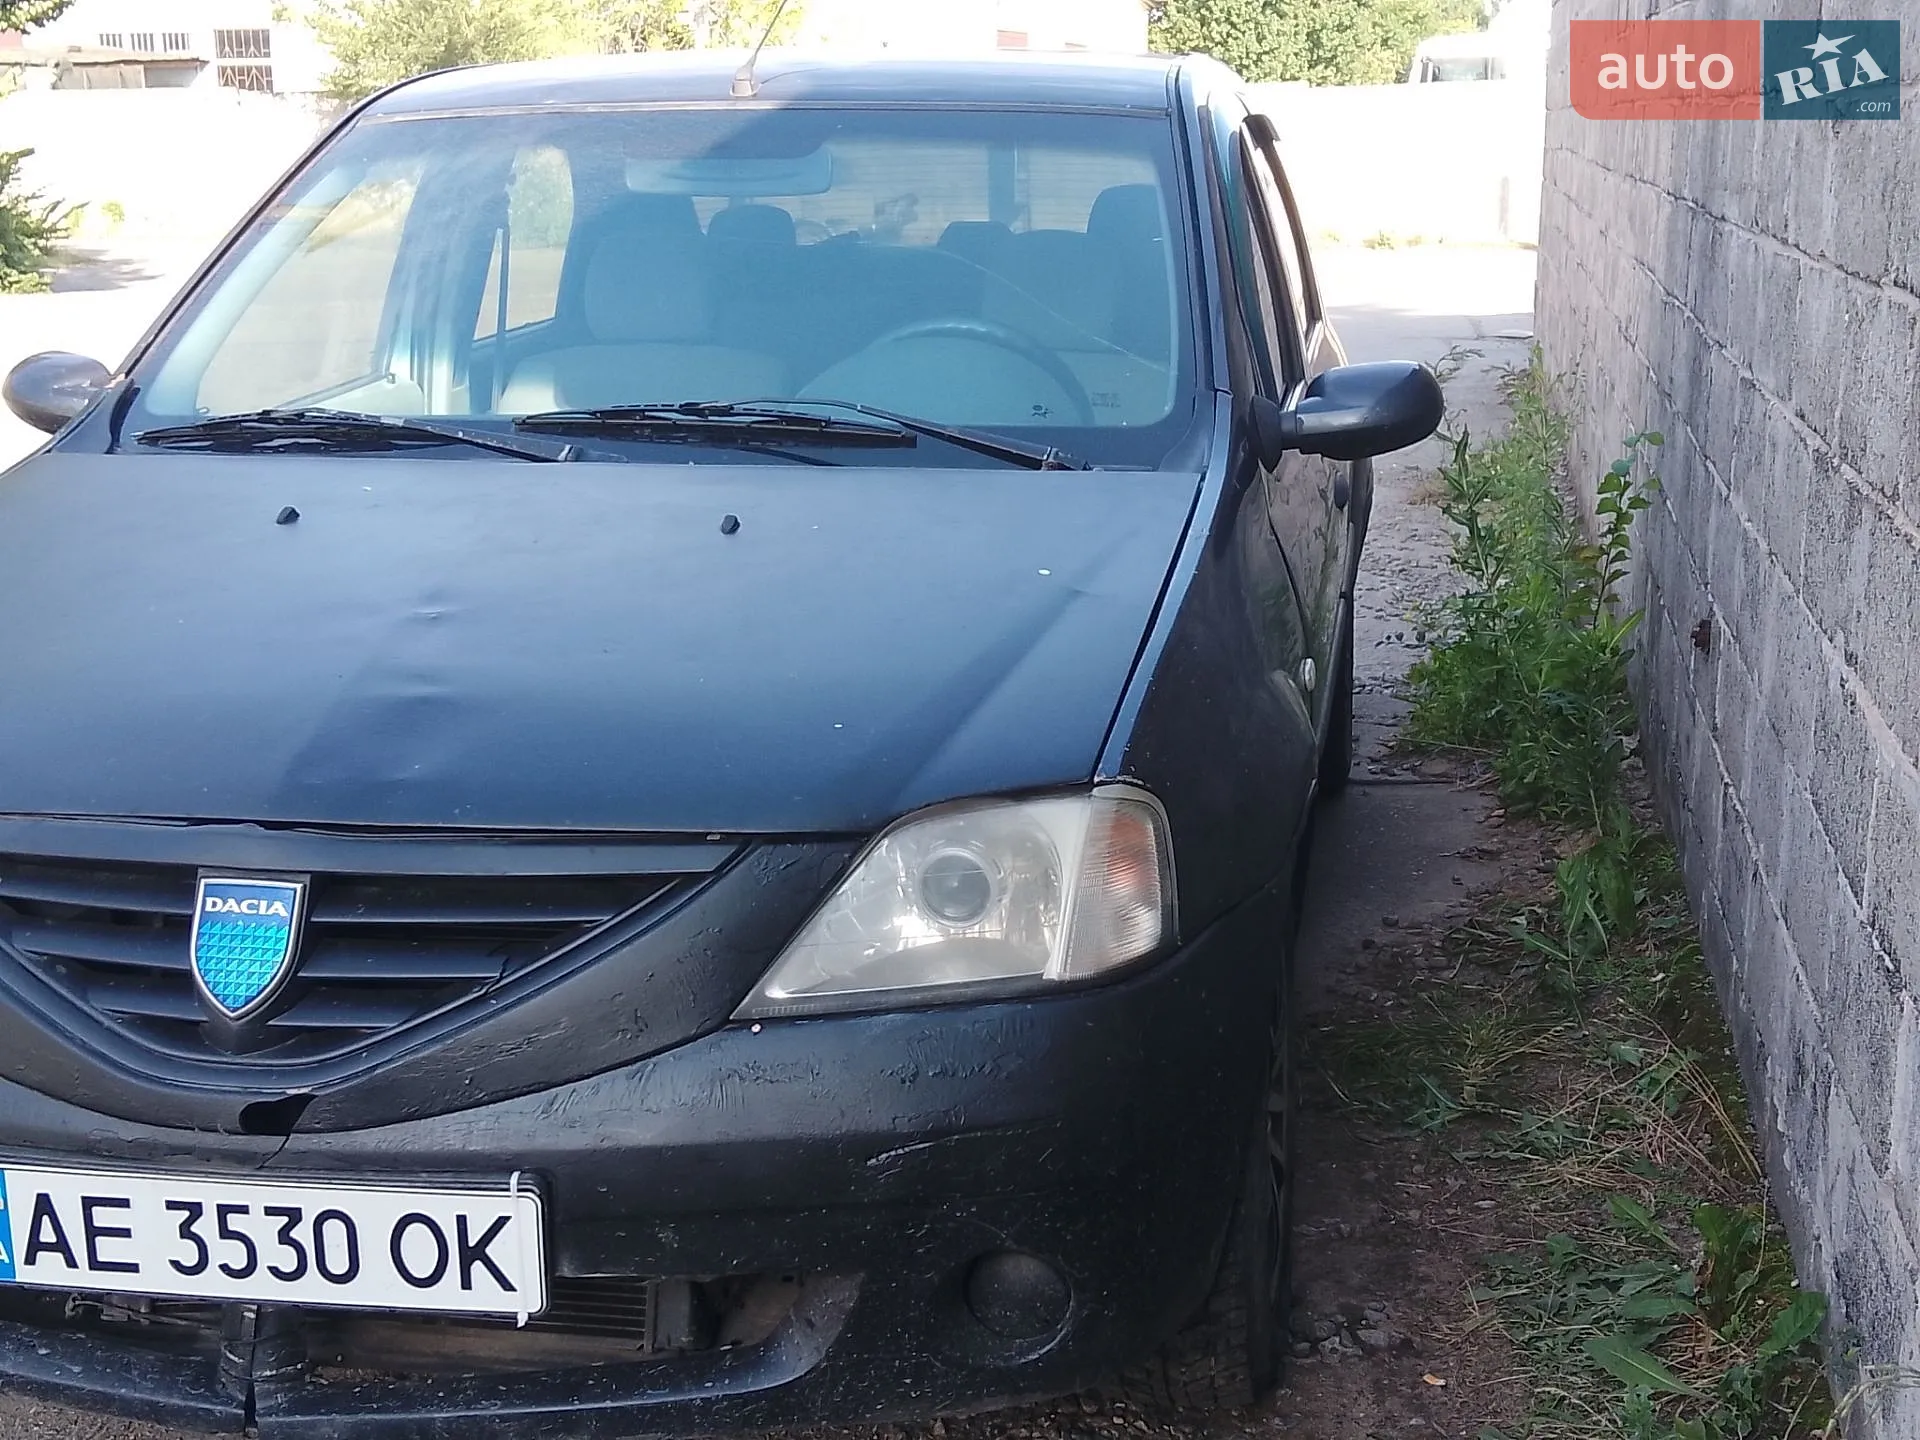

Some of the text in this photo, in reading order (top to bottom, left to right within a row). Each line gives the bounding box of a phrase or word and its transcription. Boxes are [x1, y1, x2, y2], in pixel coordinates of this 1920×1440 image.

[205, 897, 288, 917] DACIA
[23, 1192, 518, 1293] AE 3530 OK
